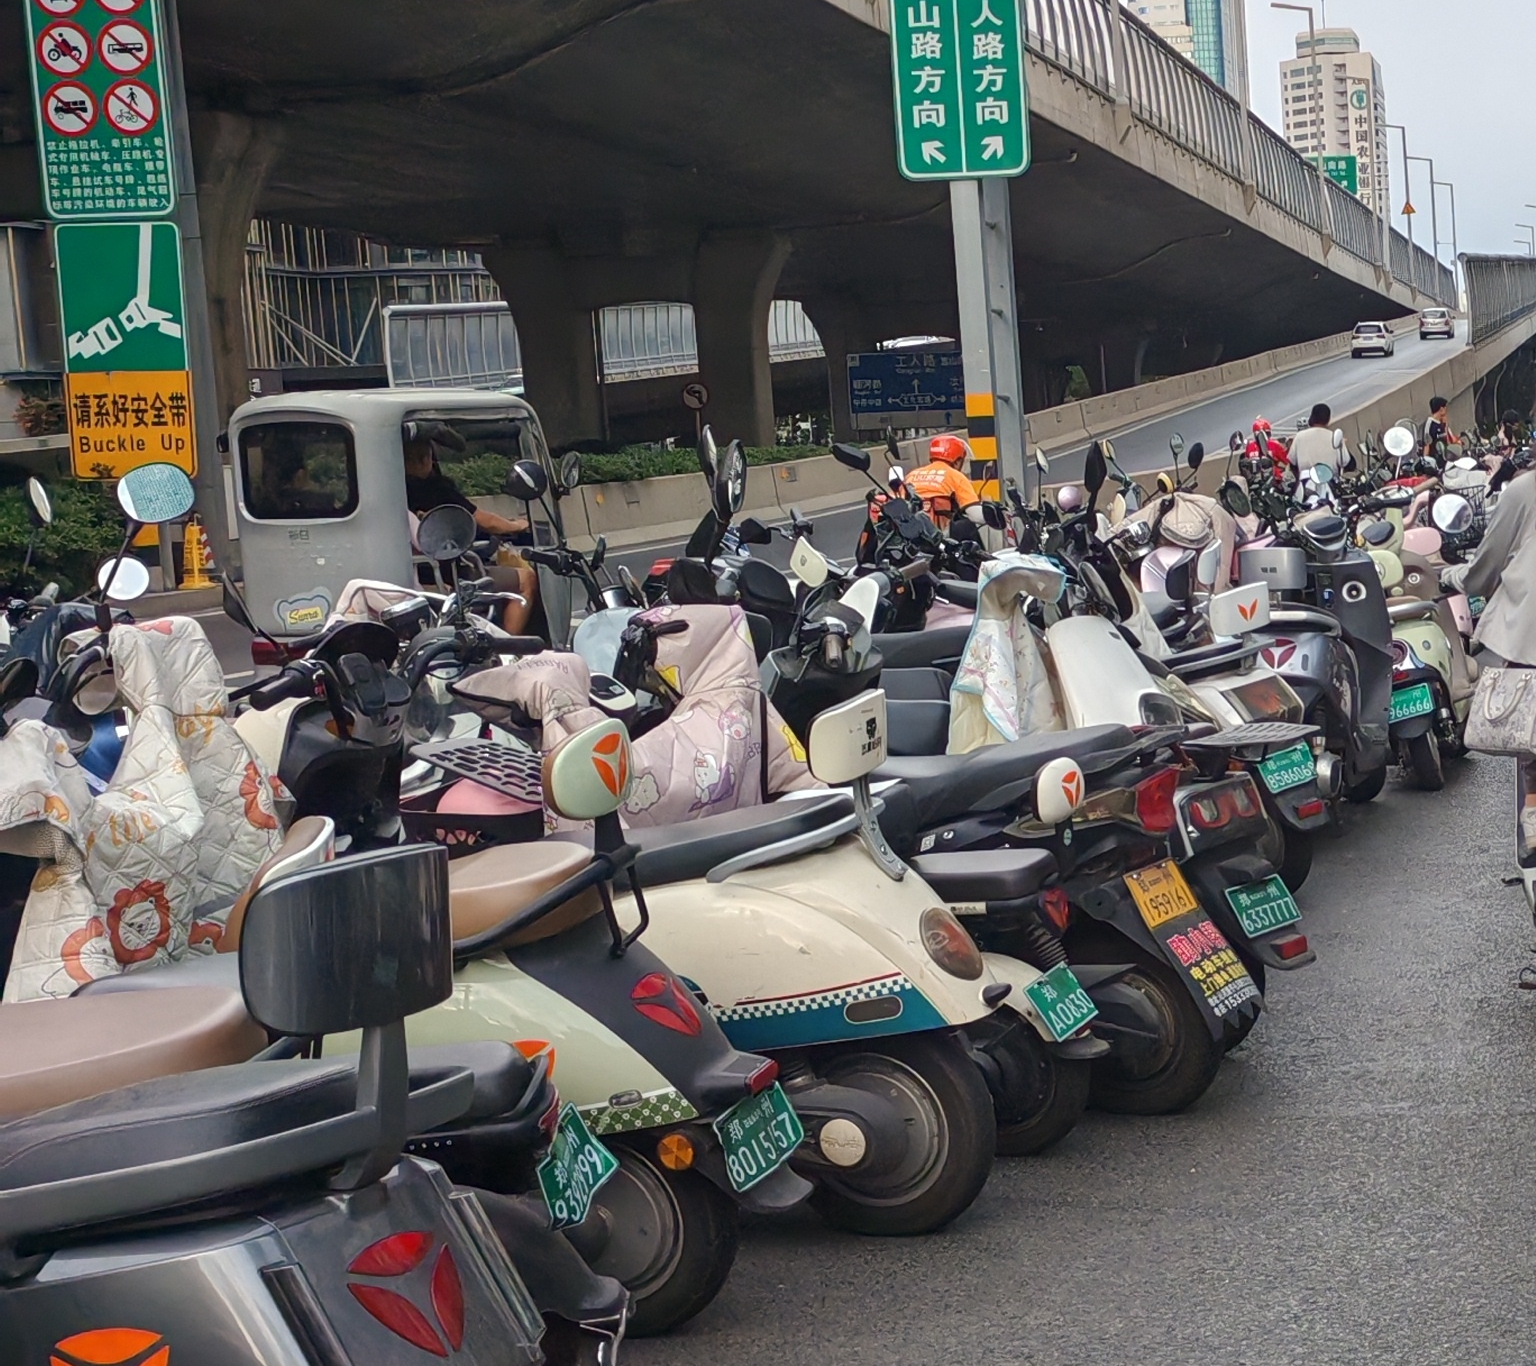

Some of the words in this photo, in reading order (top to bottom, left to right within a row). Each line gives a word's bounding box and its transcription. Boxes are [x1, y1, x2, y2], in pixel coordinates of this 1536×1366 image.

[73, 392, 187, 430] 请系好安全带
[79, 434, 146, 453] Buckle
[161, 434, 185, 455] Up
[727, 1118, 744, 1144] 郑
